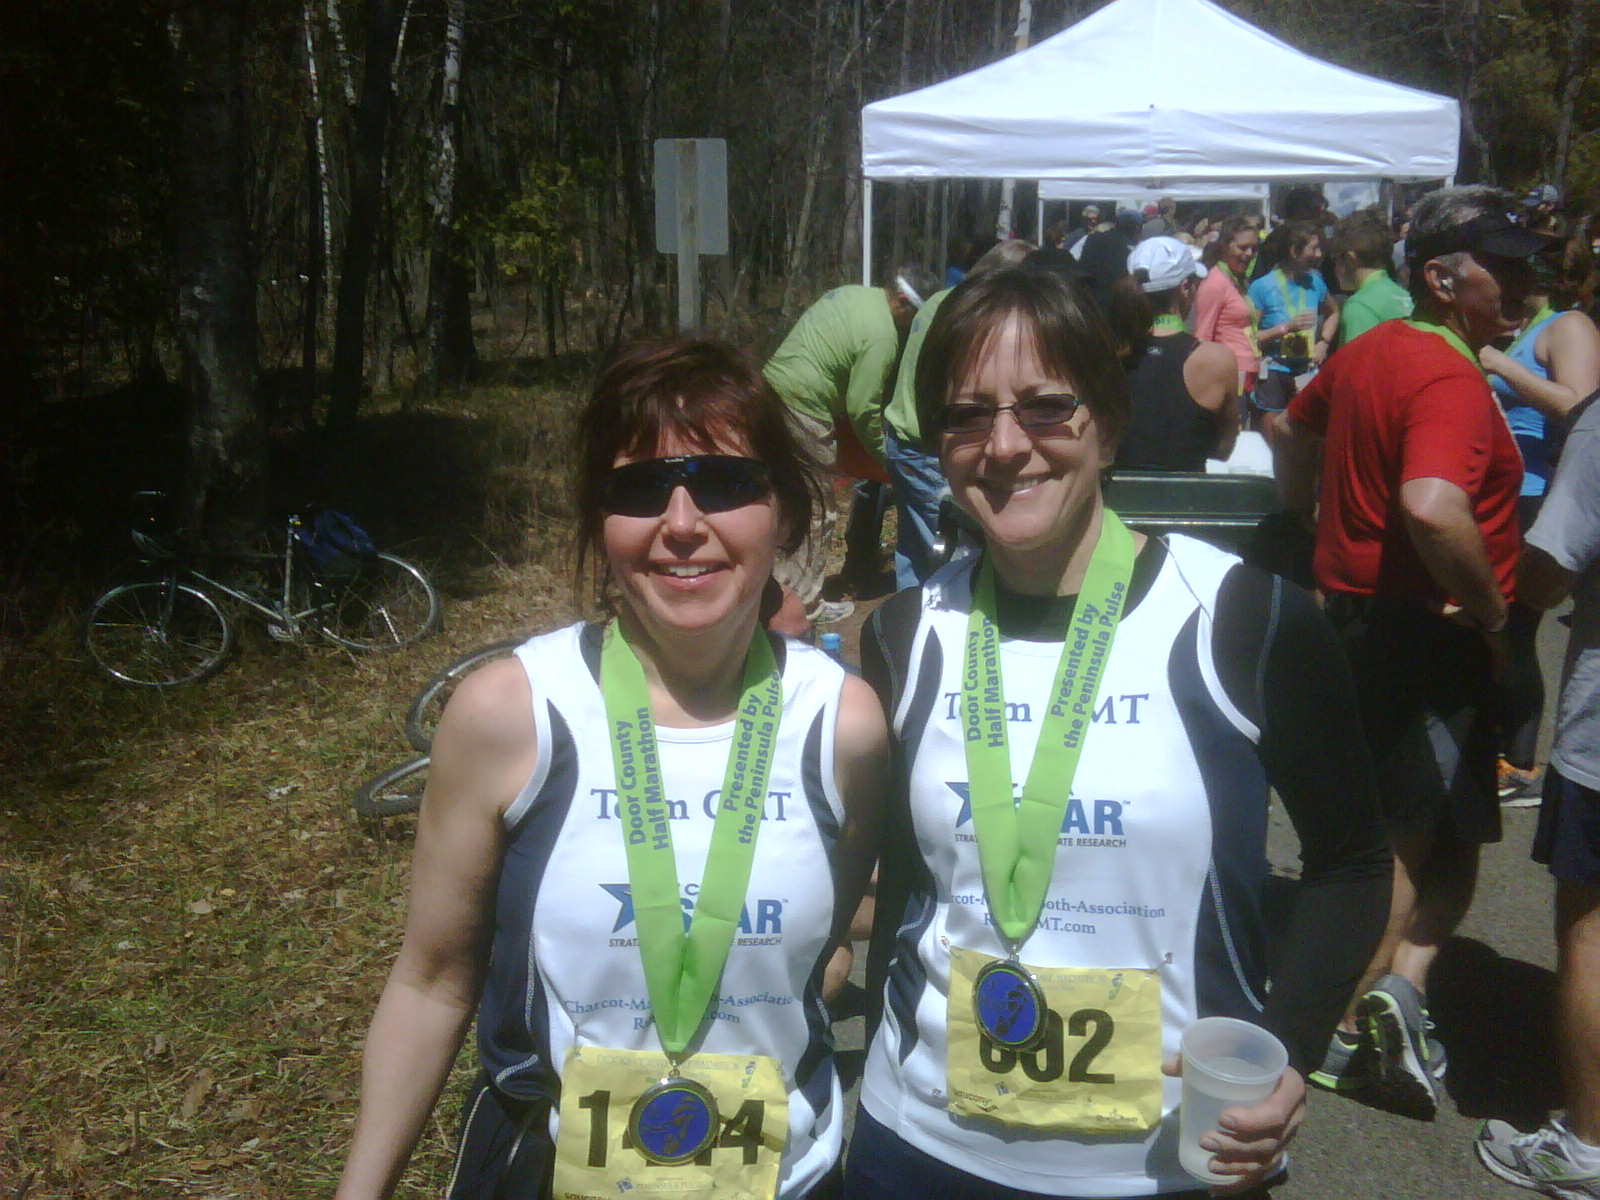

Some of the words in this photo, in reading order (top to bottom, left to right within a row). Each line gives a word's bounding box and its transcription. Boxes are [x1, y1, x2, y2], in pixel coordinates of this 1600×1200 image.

[1100, 581, 1126, 628] Pulse
[981, 616, 1000, 702] Marathon
[1051, 626, 1090, 717] Presented
[1077, 602, 1100, 626] by
[1072, 631, 1111, 715] Peninsula
[762, 671, 780, 718] Pulse
[966, 693, 982, 742] Door
[1092, 693, 1149, 724] MT
[984, 703, 1004, 748] Half
[1063, 717, 1083, 749] the
[616, 720, 637, 791] County
[637, 706, 662, 804] Marathon
[723, 718, 755, 812] Presented
[742, 694, 763, 717] by
[745, 721, 774, 811] Peninsula
[629, 794, 646, 845] Door
[646, 806, 669, 850] Half
[738, 813, 756, 844] the
[1077, 838, 1127, 848] RESEARCH
[736, 937, 783, 948] RESEARCH
